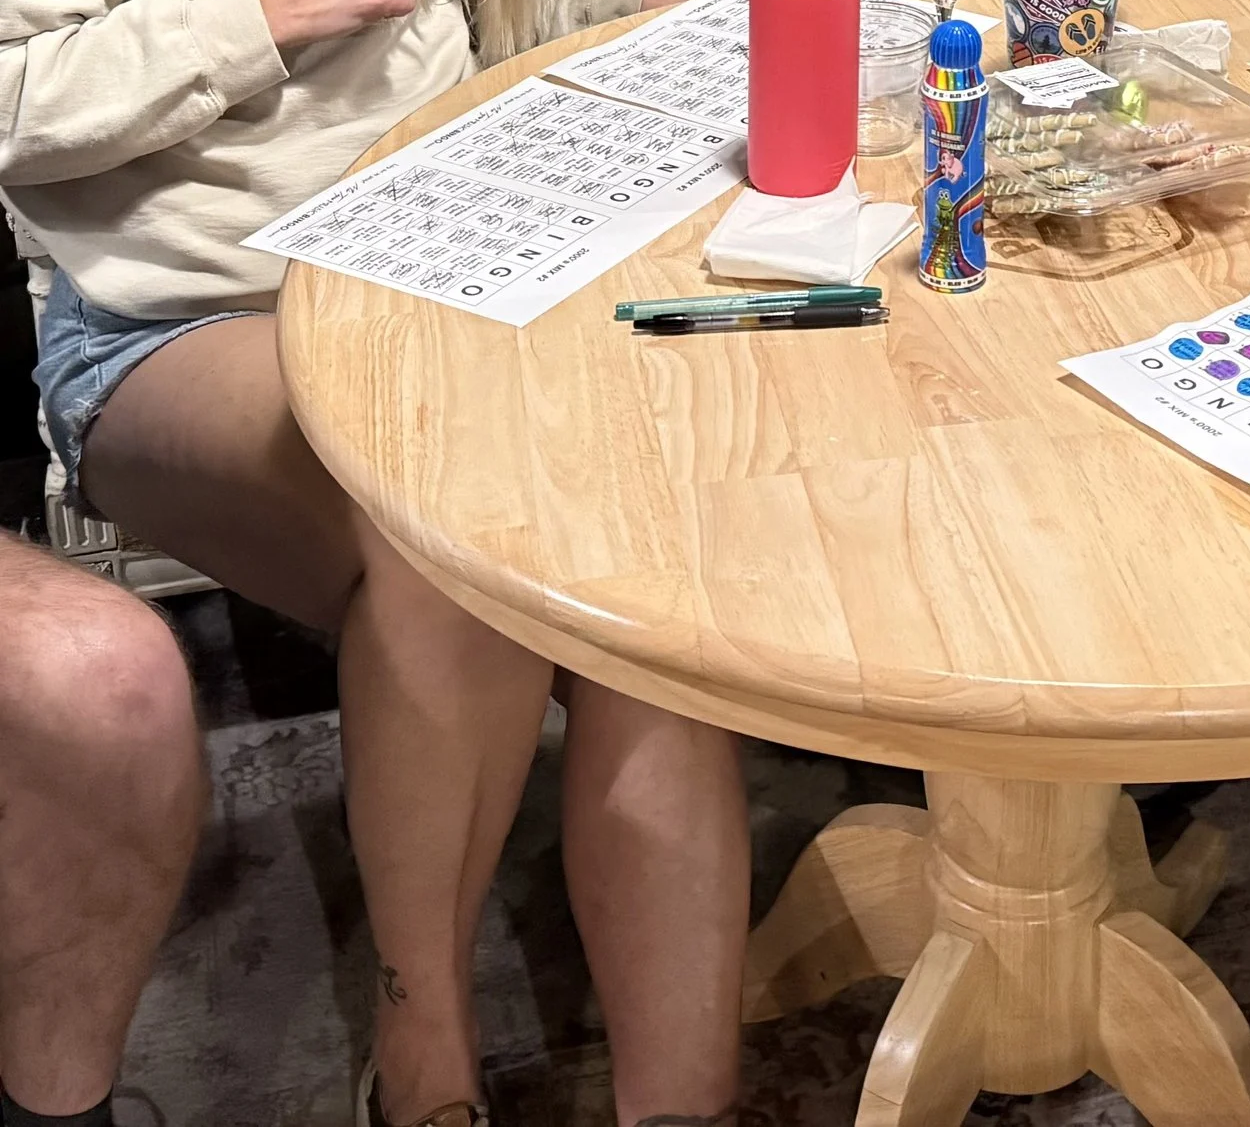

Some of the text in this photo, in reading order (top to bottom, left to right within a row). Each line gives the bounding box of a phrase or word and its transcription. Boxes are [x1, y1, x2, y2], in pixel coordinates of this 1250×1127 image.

[703, 135, 724, 143] B
[657, 163, 679, 173] N
[634, 179, 654, 187] G
[610, 193, 630, 202] O
[572, 216, 594, 225] B
[517, 249, 541, 259] N
[490, 267, 512, 277] G
[462, 285, 483, 295] O
[1142, 359, 1163, 369] O
[1174, 379, 1196, 390] G
[1208, 398, 1234, 409] N
[1168, 405, 1189, 417] MIX
